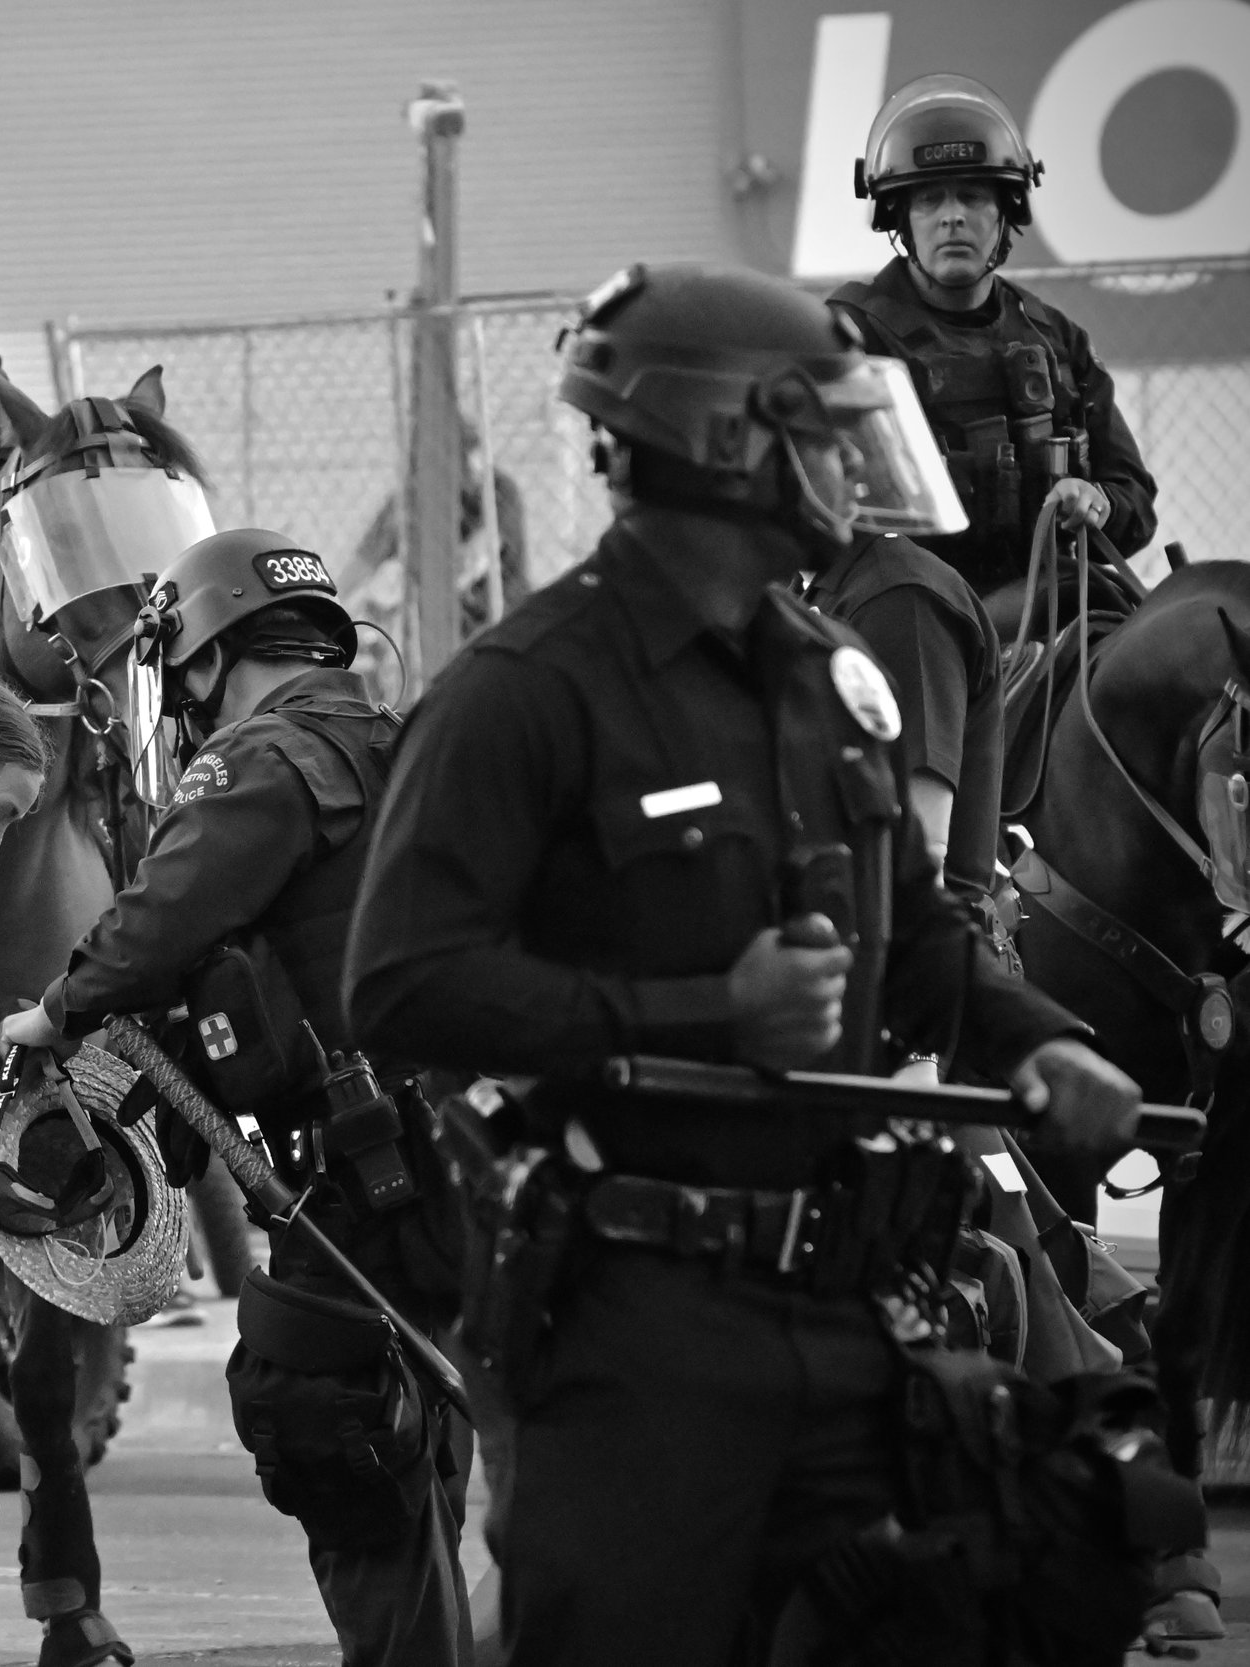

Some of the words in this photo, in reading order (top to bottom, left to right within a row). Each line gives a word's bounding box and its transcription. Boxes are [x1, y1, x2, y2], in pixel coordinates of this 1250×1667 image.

[924, 143, 974, 160] COFFEY
[267, 556, 330, 584] 33854
[192, 753, 228, 787] ANGELES
[1, 1044, 18, 1081] KLEIN
